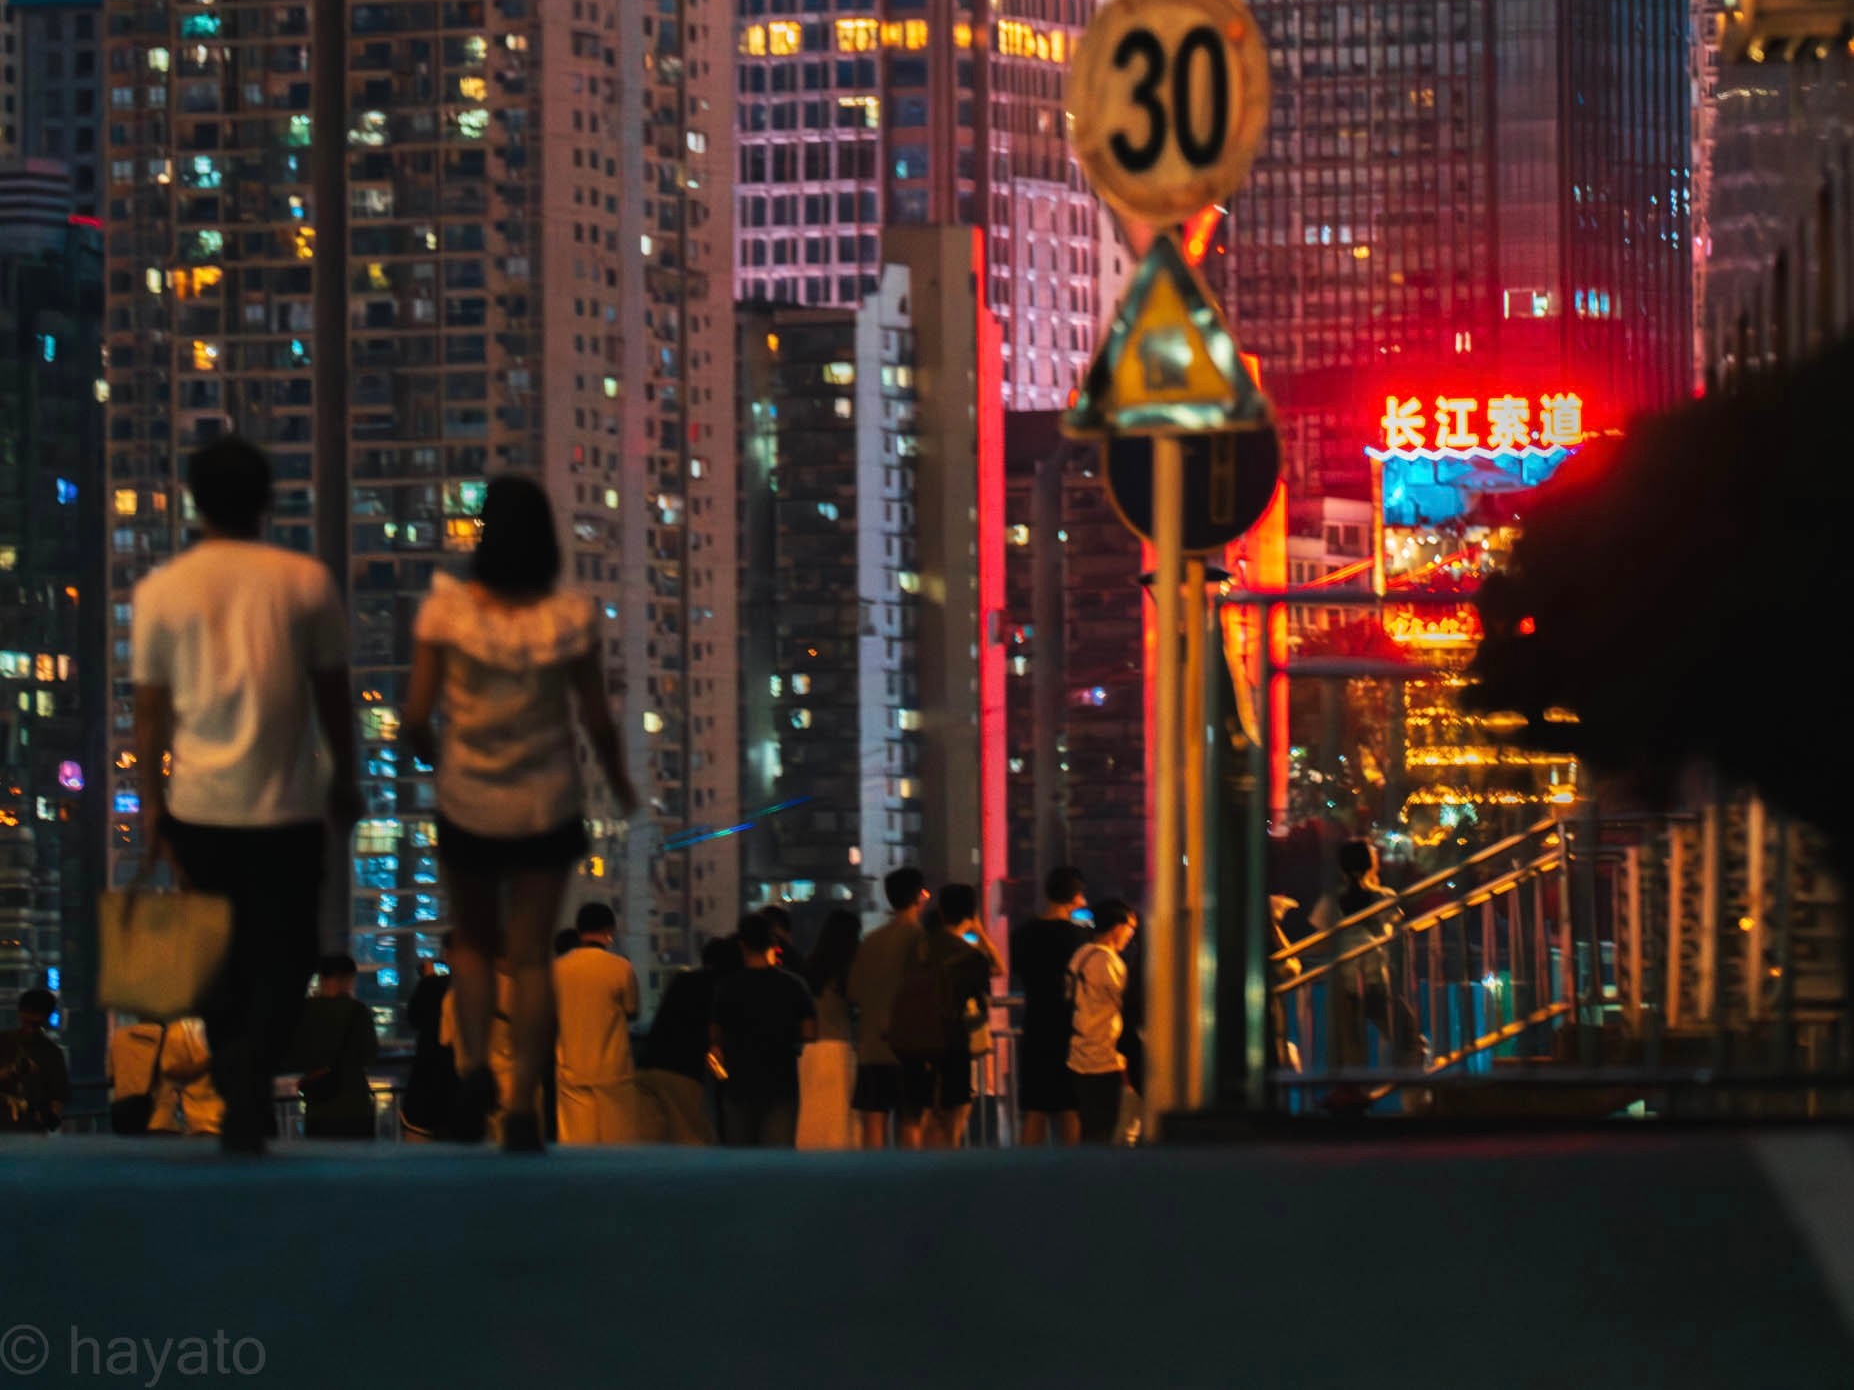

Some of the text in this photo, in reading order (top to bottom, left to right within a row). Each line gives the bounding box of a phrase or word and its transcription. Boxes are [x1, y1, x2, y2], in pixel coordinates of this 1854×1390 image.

[1110, 24, 1229, 173] 30
[1381, 393, 1584, 448] 长江索道
